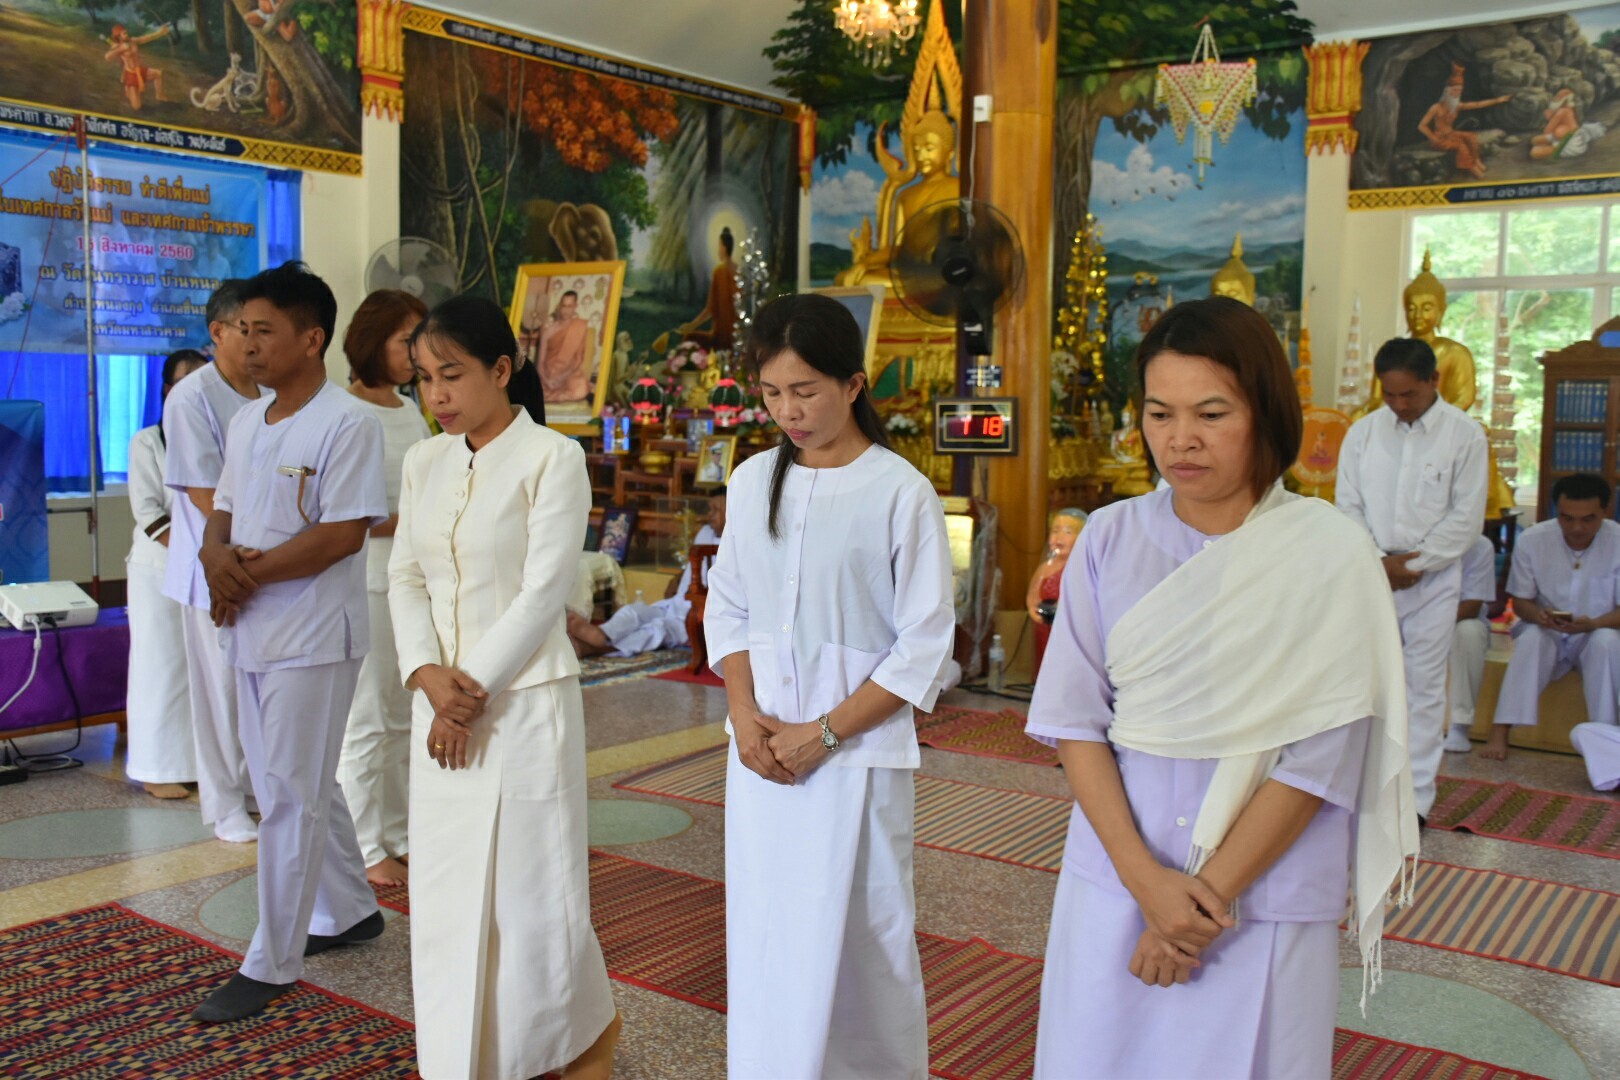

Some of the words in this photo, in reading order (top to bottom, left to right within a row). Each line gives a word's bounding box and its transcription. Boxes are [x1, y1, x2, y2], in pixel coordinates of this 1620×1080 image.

[0, 190, 113, 225] นเทศกาลวัแม่
[102, 236, 154, 256] สิงหาคม
[85, 319, 187, 338] ังหวัดมหาสารคาม
